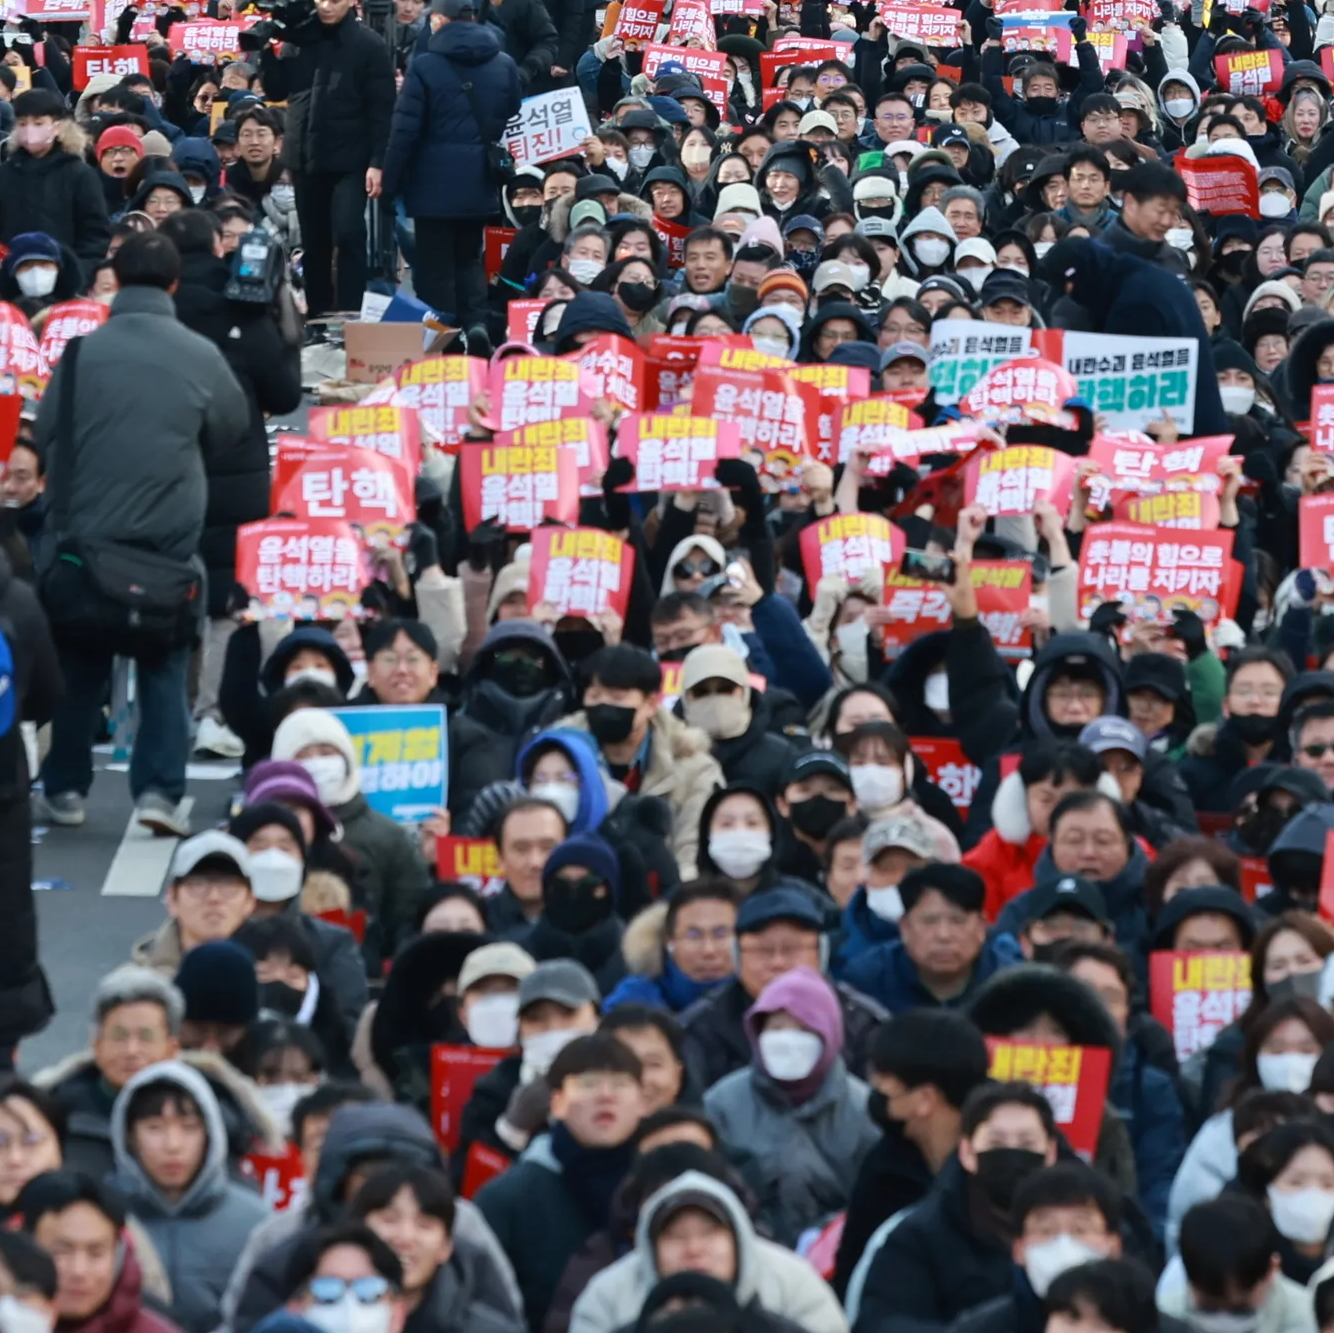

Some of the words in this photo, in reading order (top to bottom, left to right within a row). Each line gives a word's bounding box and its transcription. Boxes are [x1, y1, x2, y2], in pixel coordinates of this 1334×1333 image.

[710, 1, 744, 14] 탄핵!
[1094, 3, 1123, 17] 나라를
[1125, 2, 1152, 17] 지키자
[883, 9, 917, 23] 촛불의
[922, 11, 957, 26] 힘으로
[919, 23, 956, 36] 지키자
[1227, 52, 1270, 70] 내란죄
[1229, 67, 1272, 84] 윤석열
[507, 129, 563, 162] 퇴진!
[1068, 355, 1126, 375] 내란수괴
[1131, 348, 1189, 370] 윤석열을
[301, 469, 398, 519] 탄핵
[1087, 540, 1152, 567] 촛불의
[1157, 543, 1223, 568] 힘으로
[1083, 566, 1150, 593] 나라를
[1153, 569, 1222, 594] 지키자
